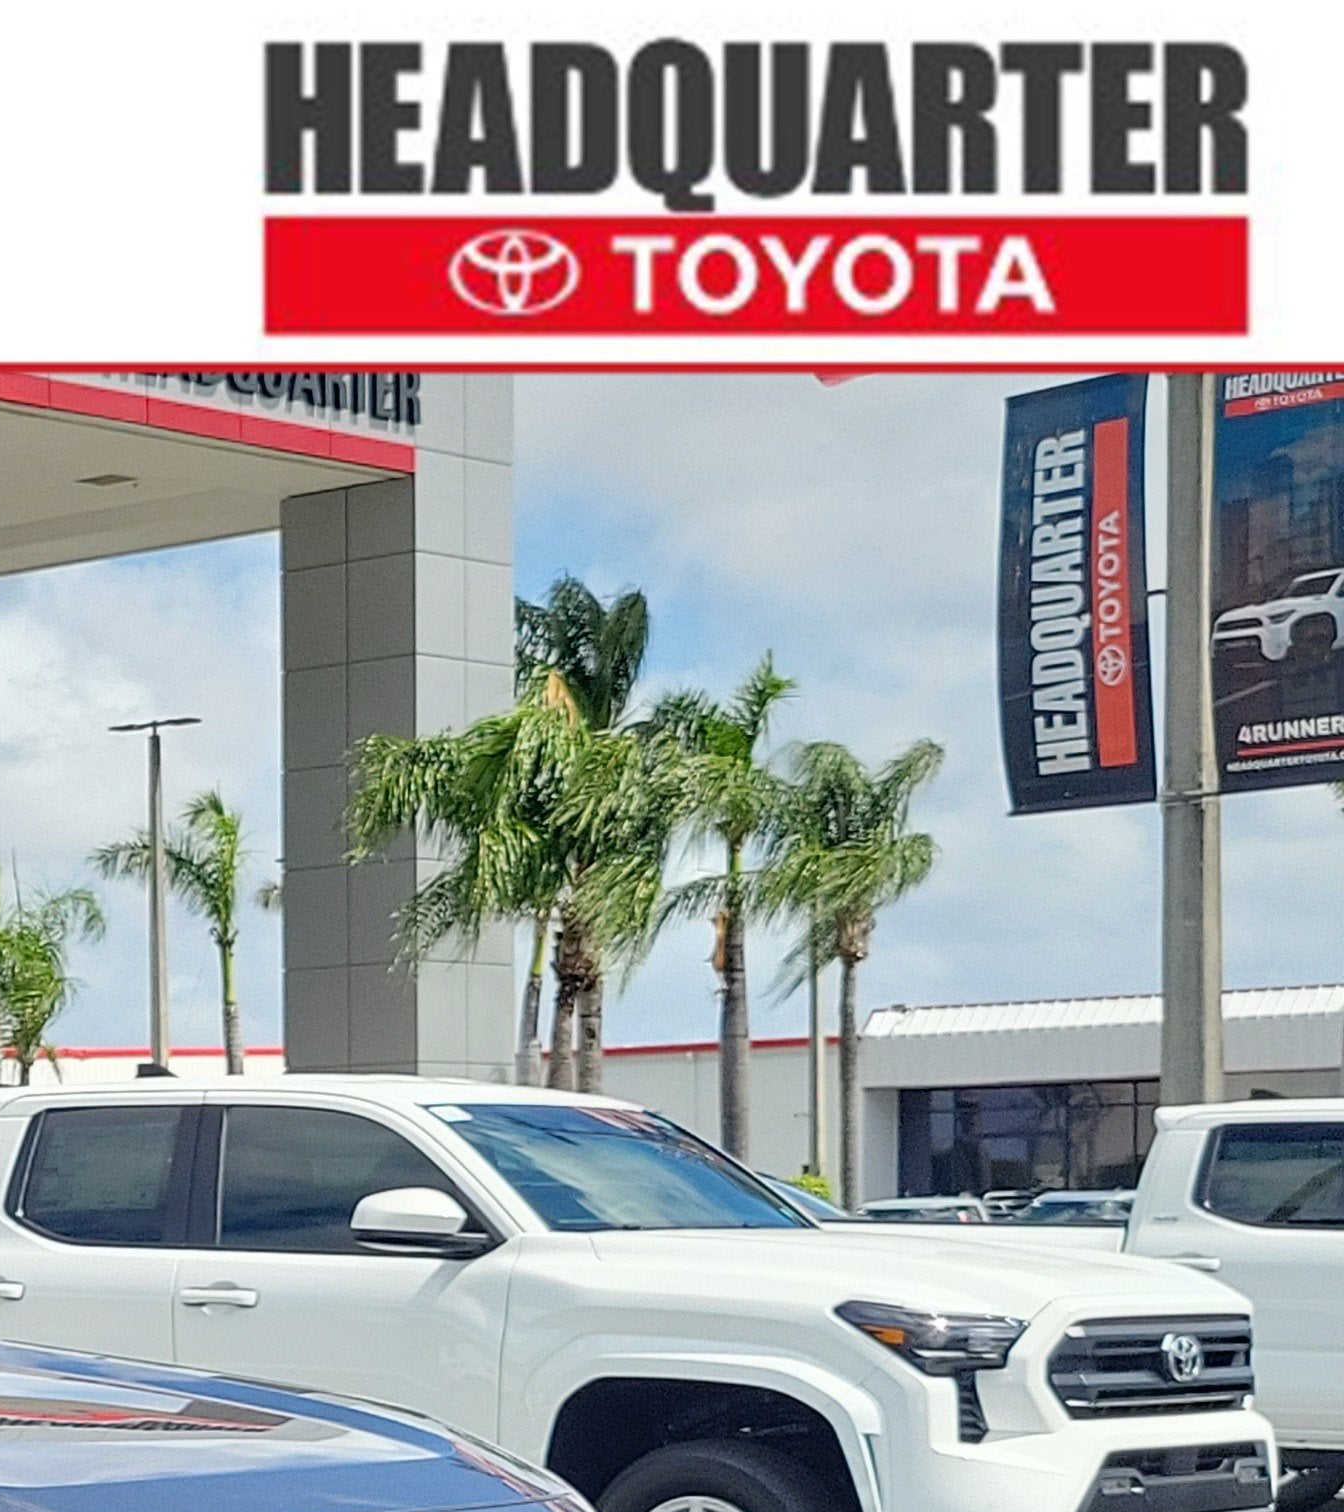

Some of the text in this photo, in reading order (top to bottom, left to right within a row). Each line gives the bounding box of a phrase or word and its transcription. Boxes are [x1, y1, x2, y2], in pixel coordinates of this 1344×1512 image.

[1030, 429, 1091, 776] HEADQUARTER
[1097, 509, 1122, 643] TOYOTA
[1238, 714, 1344, 744] 4RUNNER
